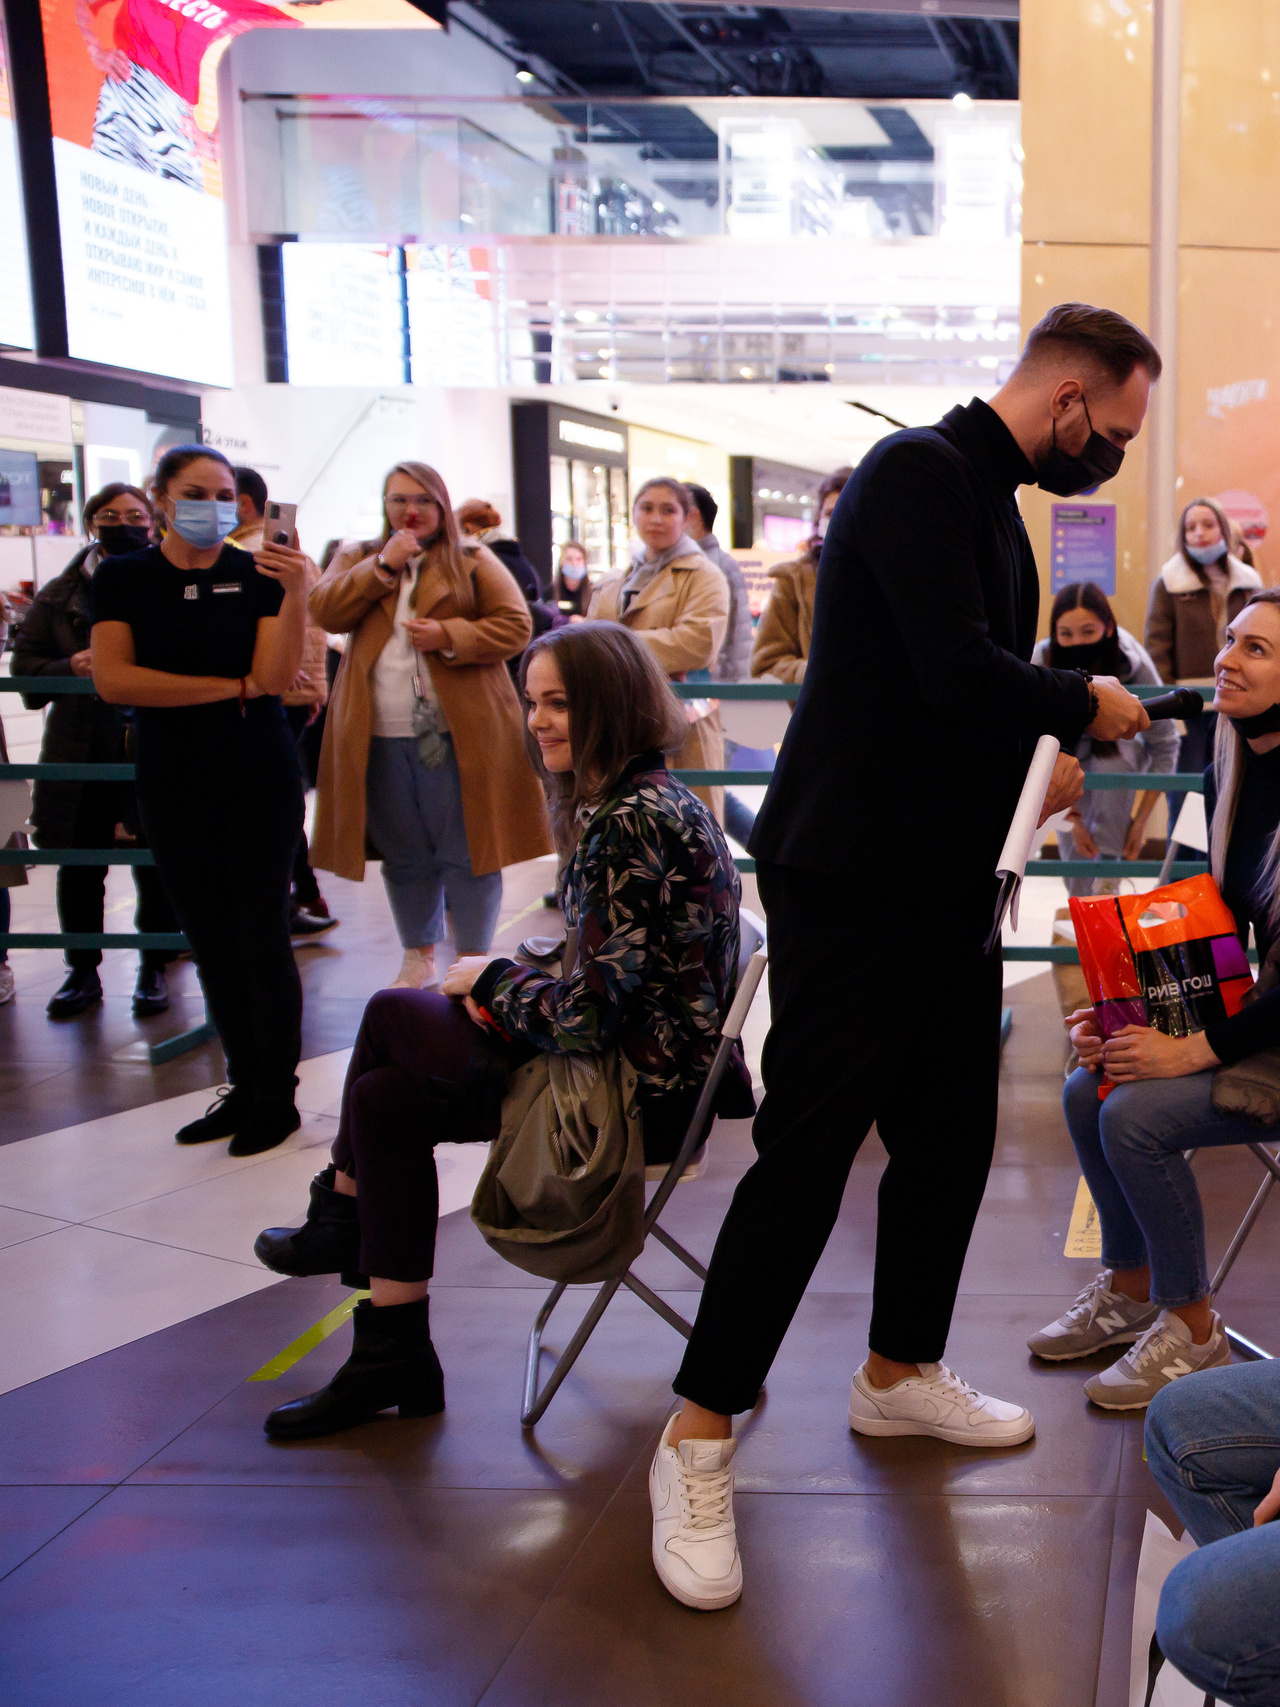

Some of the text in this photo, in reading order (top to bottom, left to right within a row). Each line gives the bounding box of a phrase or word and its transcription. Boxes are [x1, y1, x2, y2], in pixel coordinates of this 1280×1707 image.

[80, 170, 148, 208] НОВЫЙ ДЕНЬ
[82, 195, 115, 219] НОВОЕ
[83, 219, 91, 236] И
[94, 222, 141, 249] КАЖДЫЙ
[144, 239, 169, 261] ДЕНЬ
[85, 242, 142, 273] ОТКРЫВАЮ
[146, 260, 165, 280] МИР
[87, 266, 147, 297] ИНТЕРЕСНОЕ
[1147, 982, 1181, 1000] РИВ
[1182, 974, 1212, 992] ГОШ
